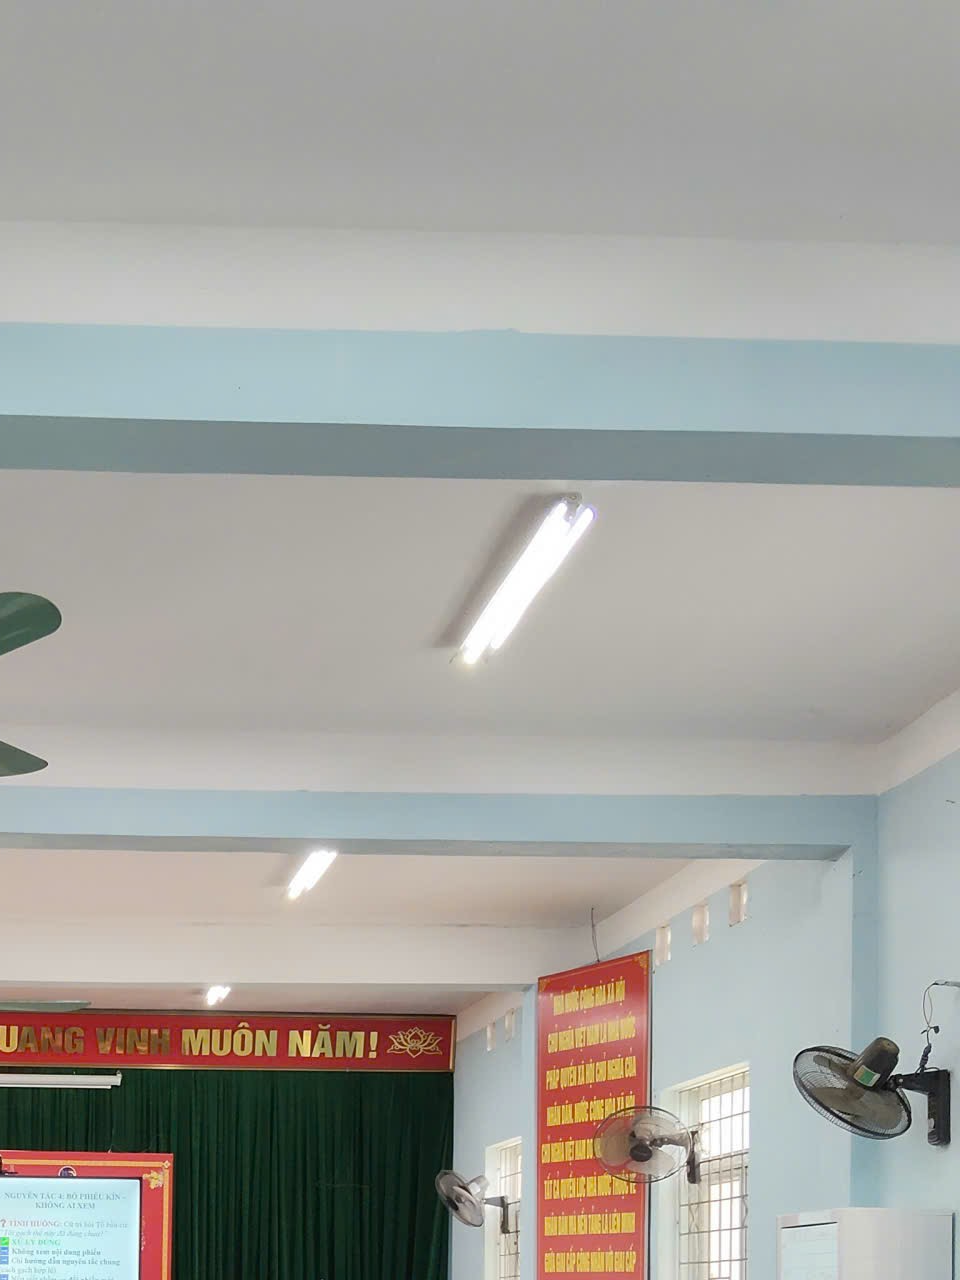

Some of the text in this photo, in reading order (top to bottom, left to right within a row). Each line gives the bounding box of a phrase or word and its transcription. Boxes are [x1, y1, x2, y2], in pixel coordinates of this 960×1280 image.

[96, 1027, 170, 1055] VINH
[181, 1021, 277, 1058] MUÔN
[288, 1023, 377, 1060] NĂM!
